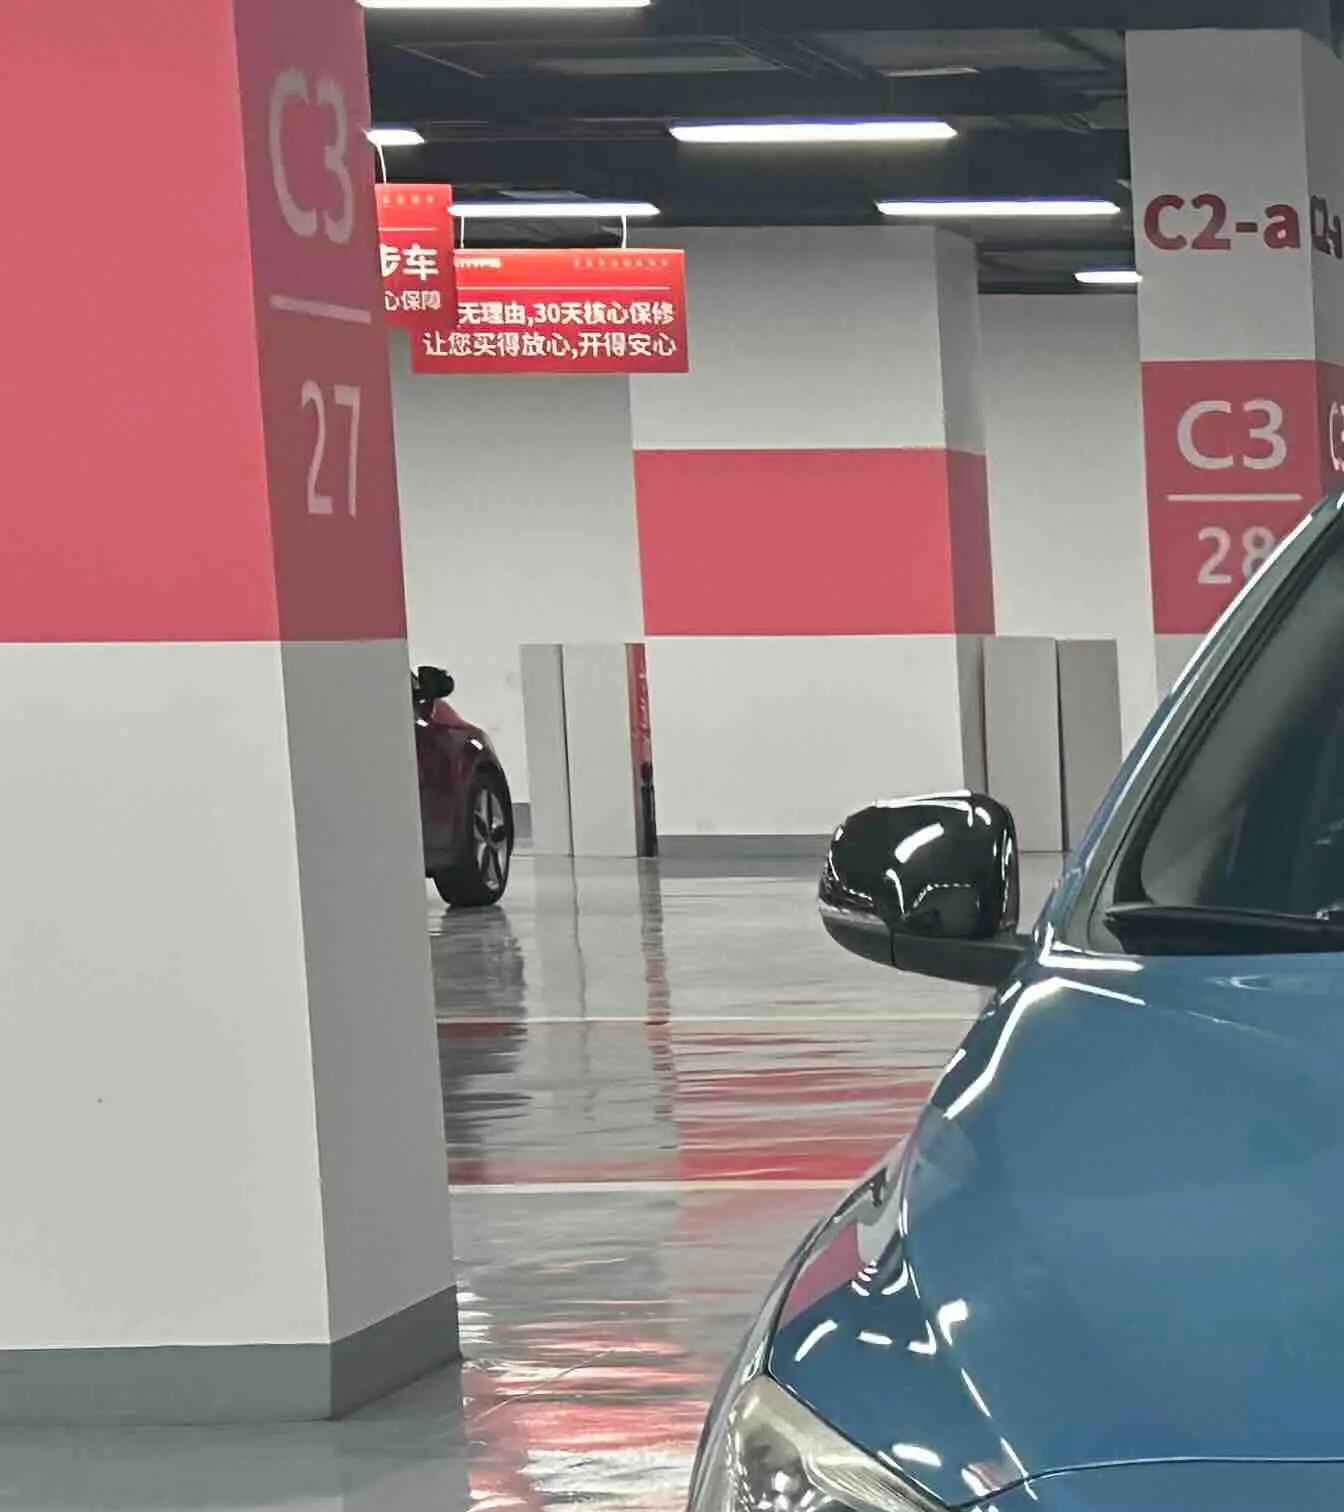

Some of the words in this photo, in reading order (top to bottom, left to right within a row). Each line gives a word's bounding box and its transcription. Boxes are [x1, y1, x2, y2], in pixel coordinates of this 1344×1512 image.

[268, 66, 356, 246] C3
[1143, 193, 1299, 251] C2-a
[301, 379, 362, 519] 27
[1177, 399, 1287, 470] C3
[1197, 526, 1275, 585] 28
